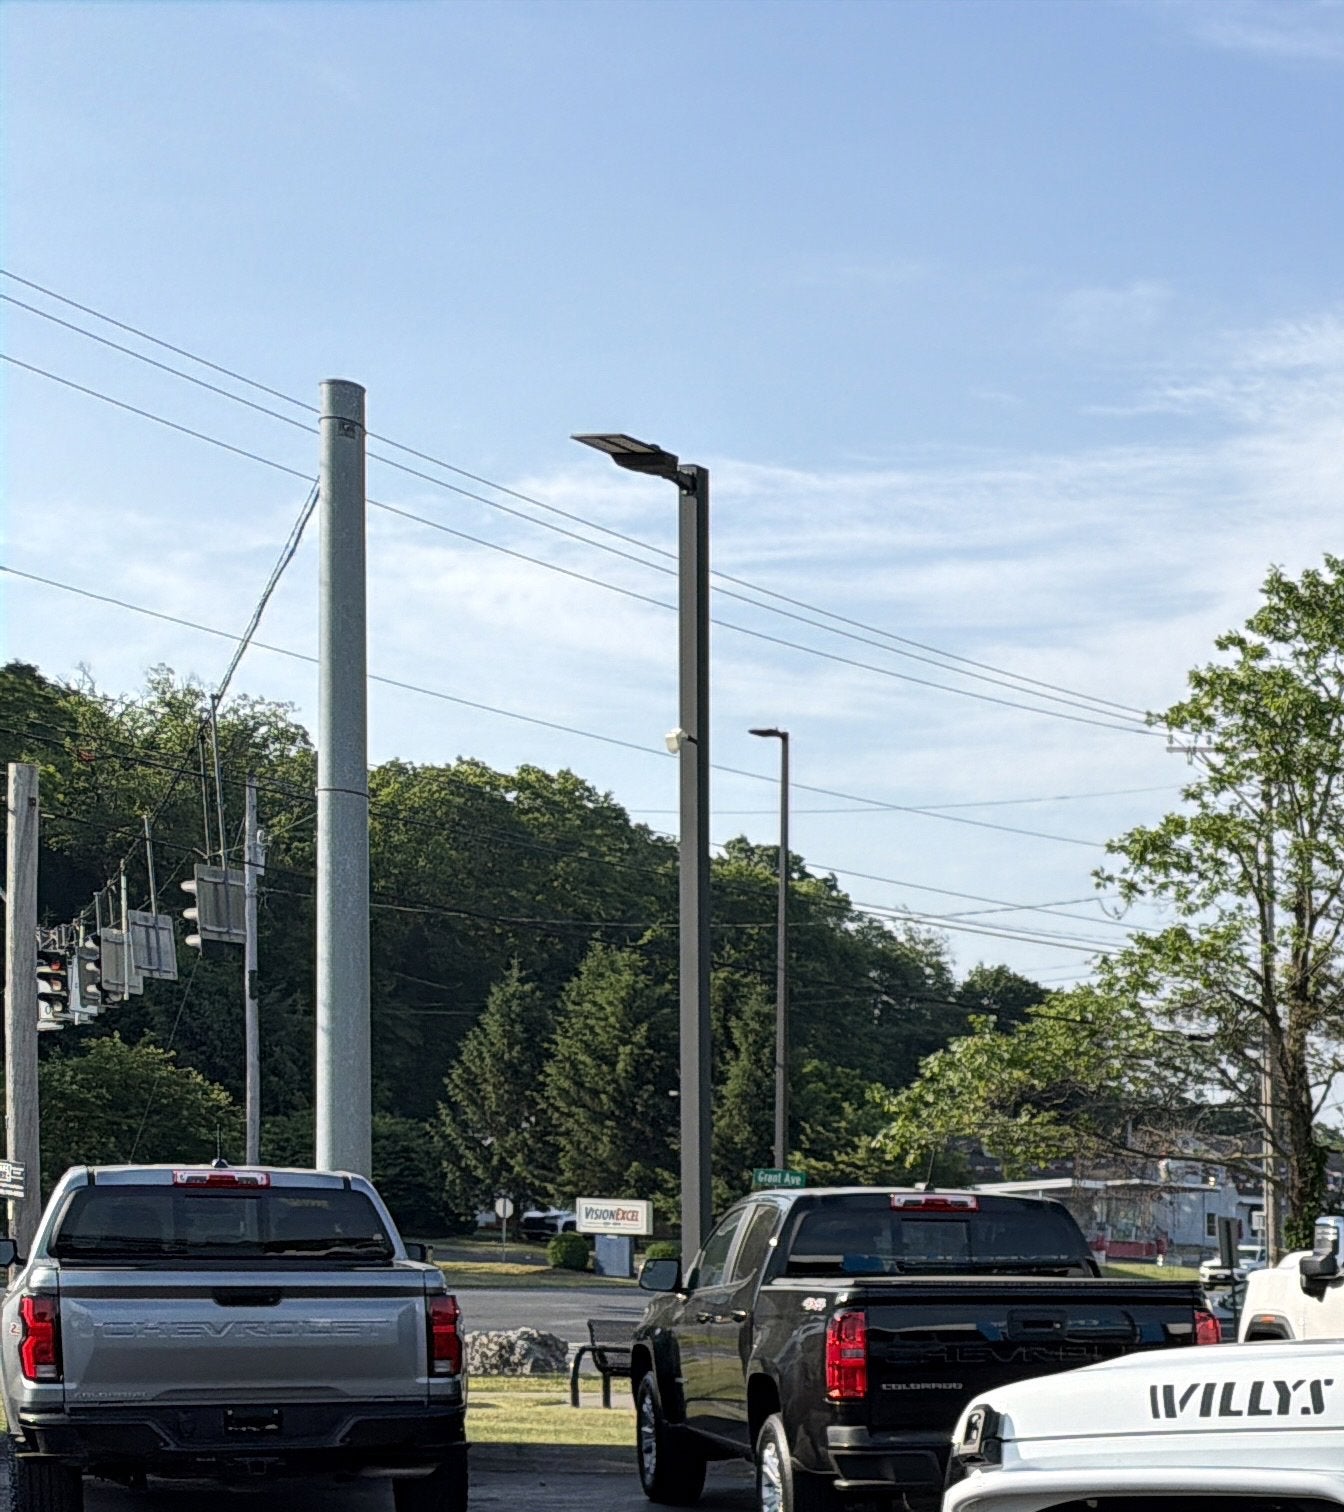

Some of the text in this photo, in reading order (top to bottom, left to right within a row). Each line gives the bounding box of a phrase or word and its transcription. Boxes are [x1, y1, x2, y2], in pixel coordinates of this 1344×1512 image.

[784, 1172, 802, 1186] Ave
[881, 1383, 964, 1391] COLORADO
[1150, 1379, 1334, 1419] WILLYS
